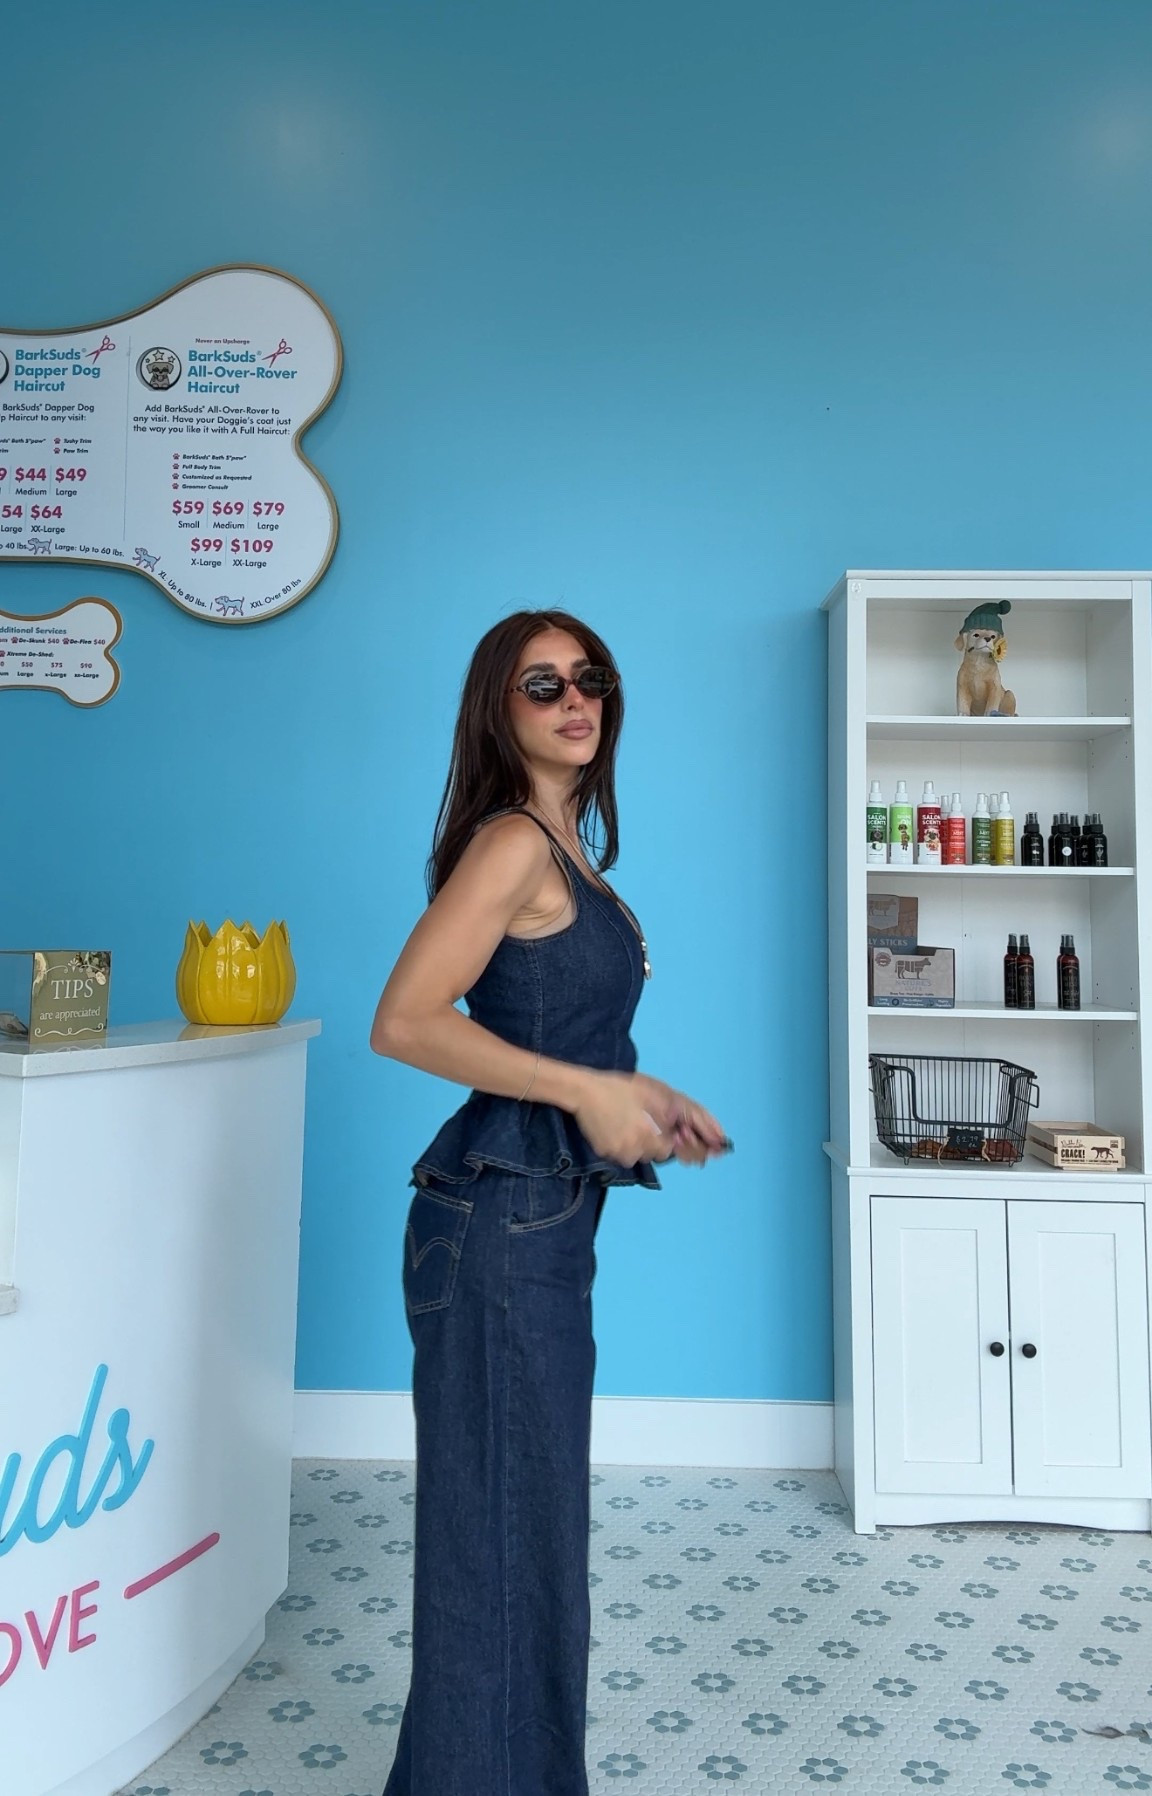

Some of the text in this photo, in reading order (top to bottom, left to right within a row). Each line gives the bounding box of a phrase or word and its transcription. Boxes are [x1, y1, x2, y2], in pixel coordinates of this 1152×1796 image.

[14, 364, 101, 378] Dapper Dog
[188, 366, 297, 379] All-Over-Rover
[14, 380, 65, 391] Haircut
[188, 382, 240, 393] Haircut
[45, 404, 75, 412] Dapper
[78, 404, 94, 412] Dog
[208, 406, 268, 415] All-Over-Rover
[218, 416, 253, 426] Doggie's
[257, 427, 290, 435] Haircut:
[15, 467, 46, 483] $44
[55, 467, 87, 483] $49
[56, 488, 77, 497] Large
[30, 504, 62, 520] $64
[172, 500, 285, 517] $59 $69 $79
[30, 525, 65, 534] XX-Large
[178, 520, 279, 531] Small Medium Large
[55, 544, 77, 552] Large:
[80, 545, 90, 553] Up
[191, 537, 273, 554] $99 $109
[191, 558, 267, 569] X-Large XX-Large
[168, 580, 177, 591] Up
[185, 593, 195, 603] 80
[264, 593, 281, 603] Over
[282, 585, 292, 594] 80
[51, 979, 93, 1000] TIPS
[40, 1006, 100, 1021] are appreciated
[1061, 1149, 1085, 1158] CRACK!
